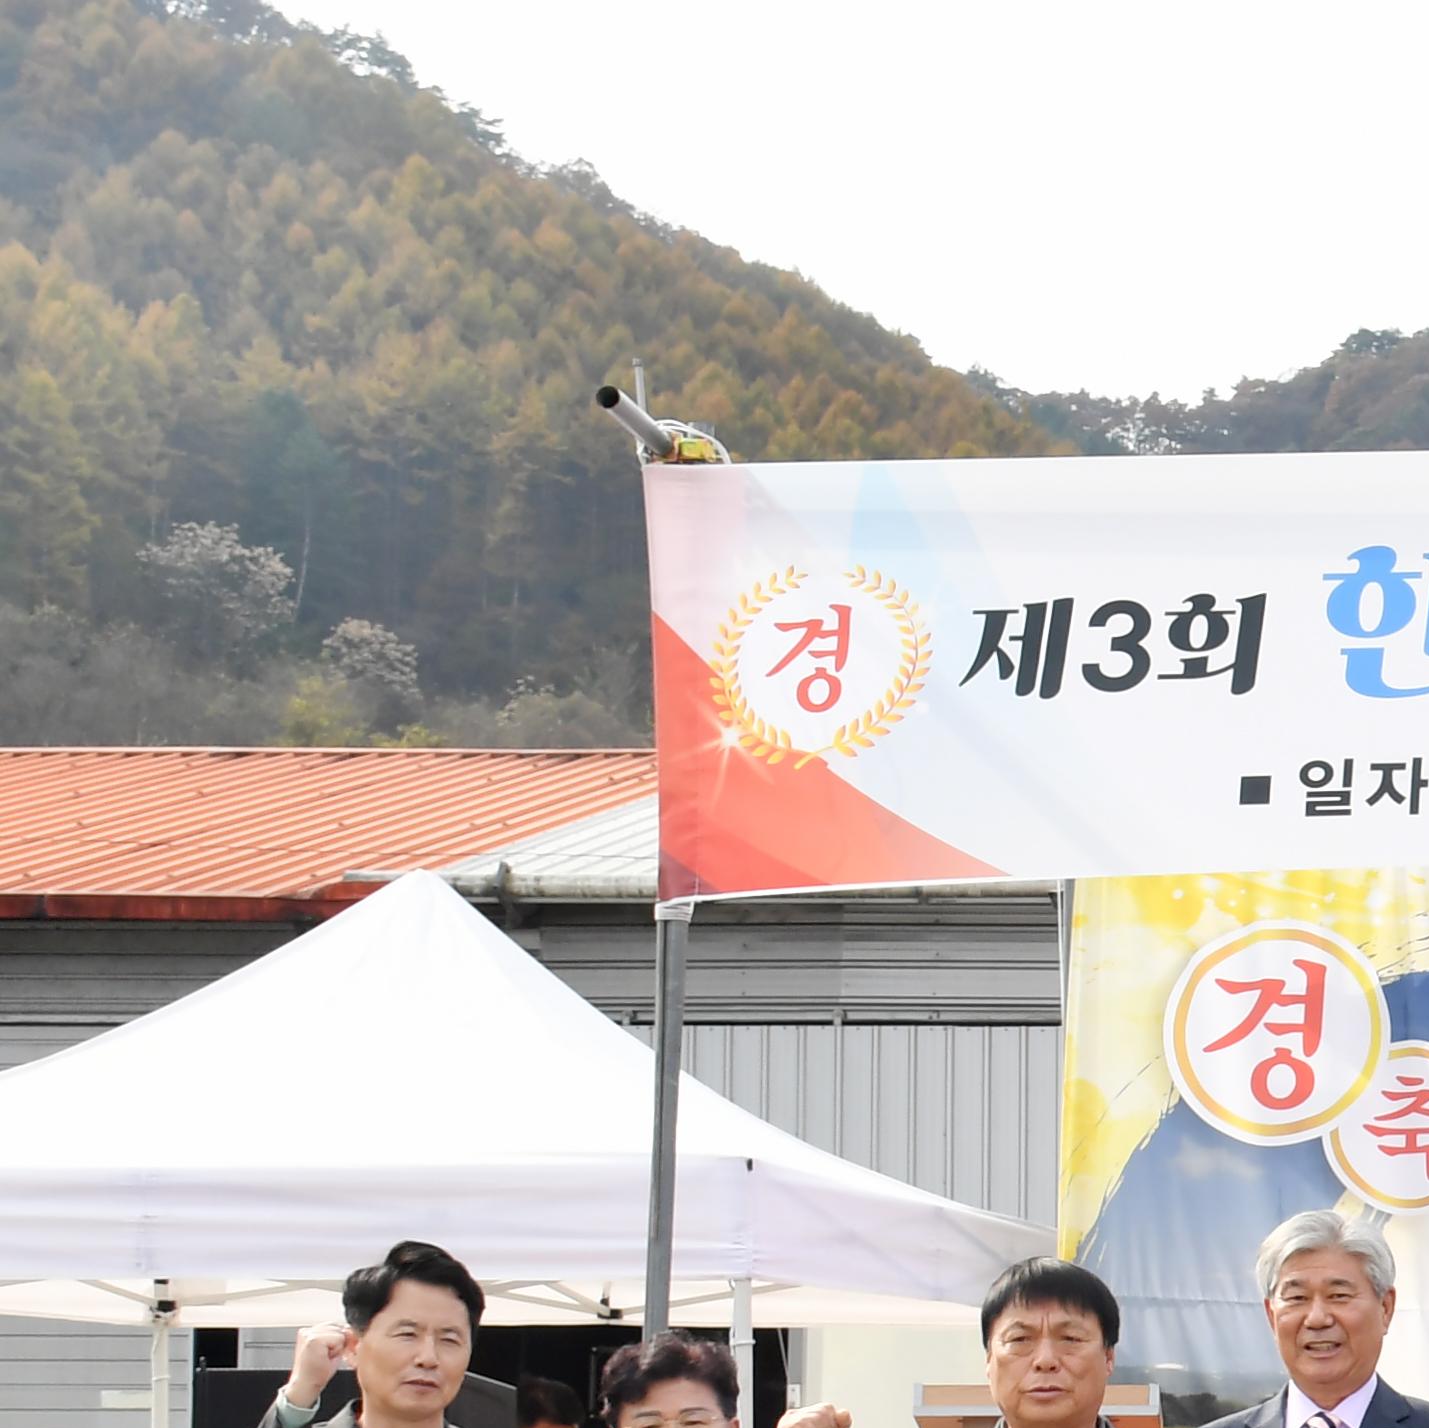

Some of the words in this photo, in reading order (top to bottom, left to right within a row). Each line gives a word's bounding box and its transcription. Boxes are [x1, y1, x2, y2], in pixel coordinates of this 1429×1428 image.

[772, 604, 851, 712] 경
[959, 592, 1267, 699] 제3회
[1202, 959, 1327, 1111] 경
